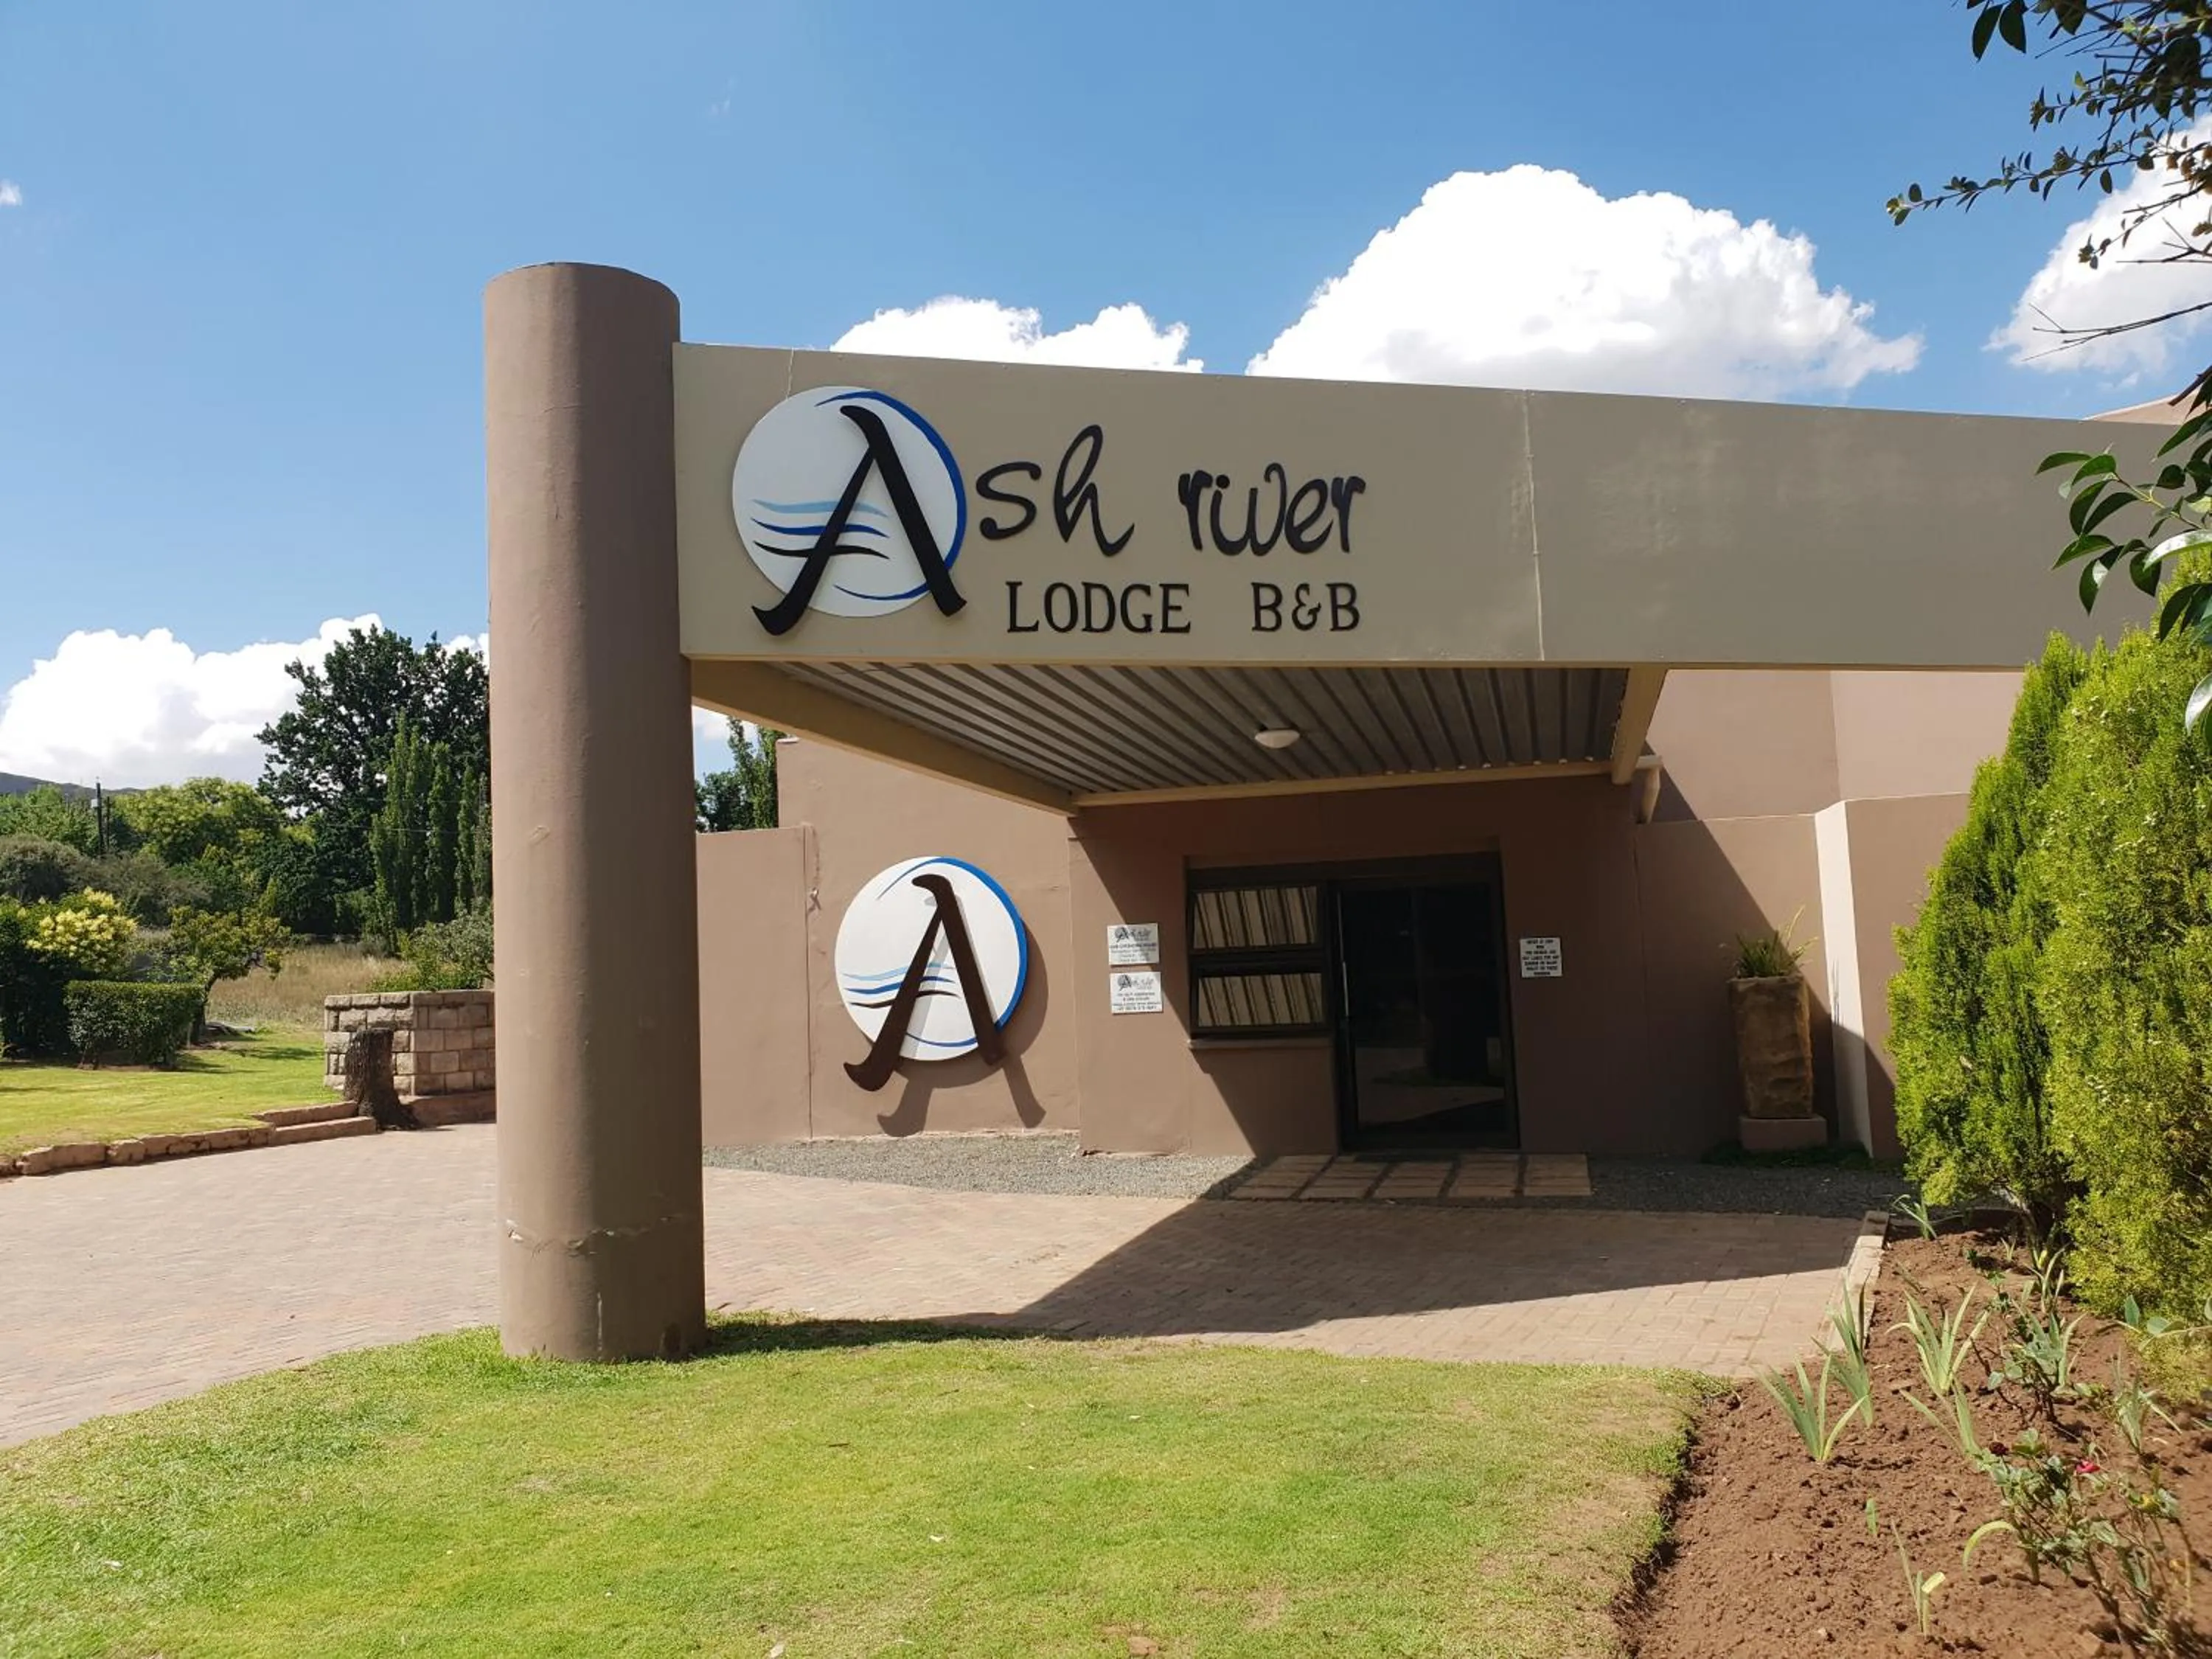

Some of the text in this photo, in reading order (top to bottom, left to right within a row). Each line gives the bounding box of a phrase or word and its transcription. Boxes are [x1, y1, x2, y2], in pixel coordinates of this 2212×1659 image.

[751, 404, 1366, 637] Ash river
[1005, 581, 1360, 634] LODGE B&B
[843, 874, 1008, 1091] A
